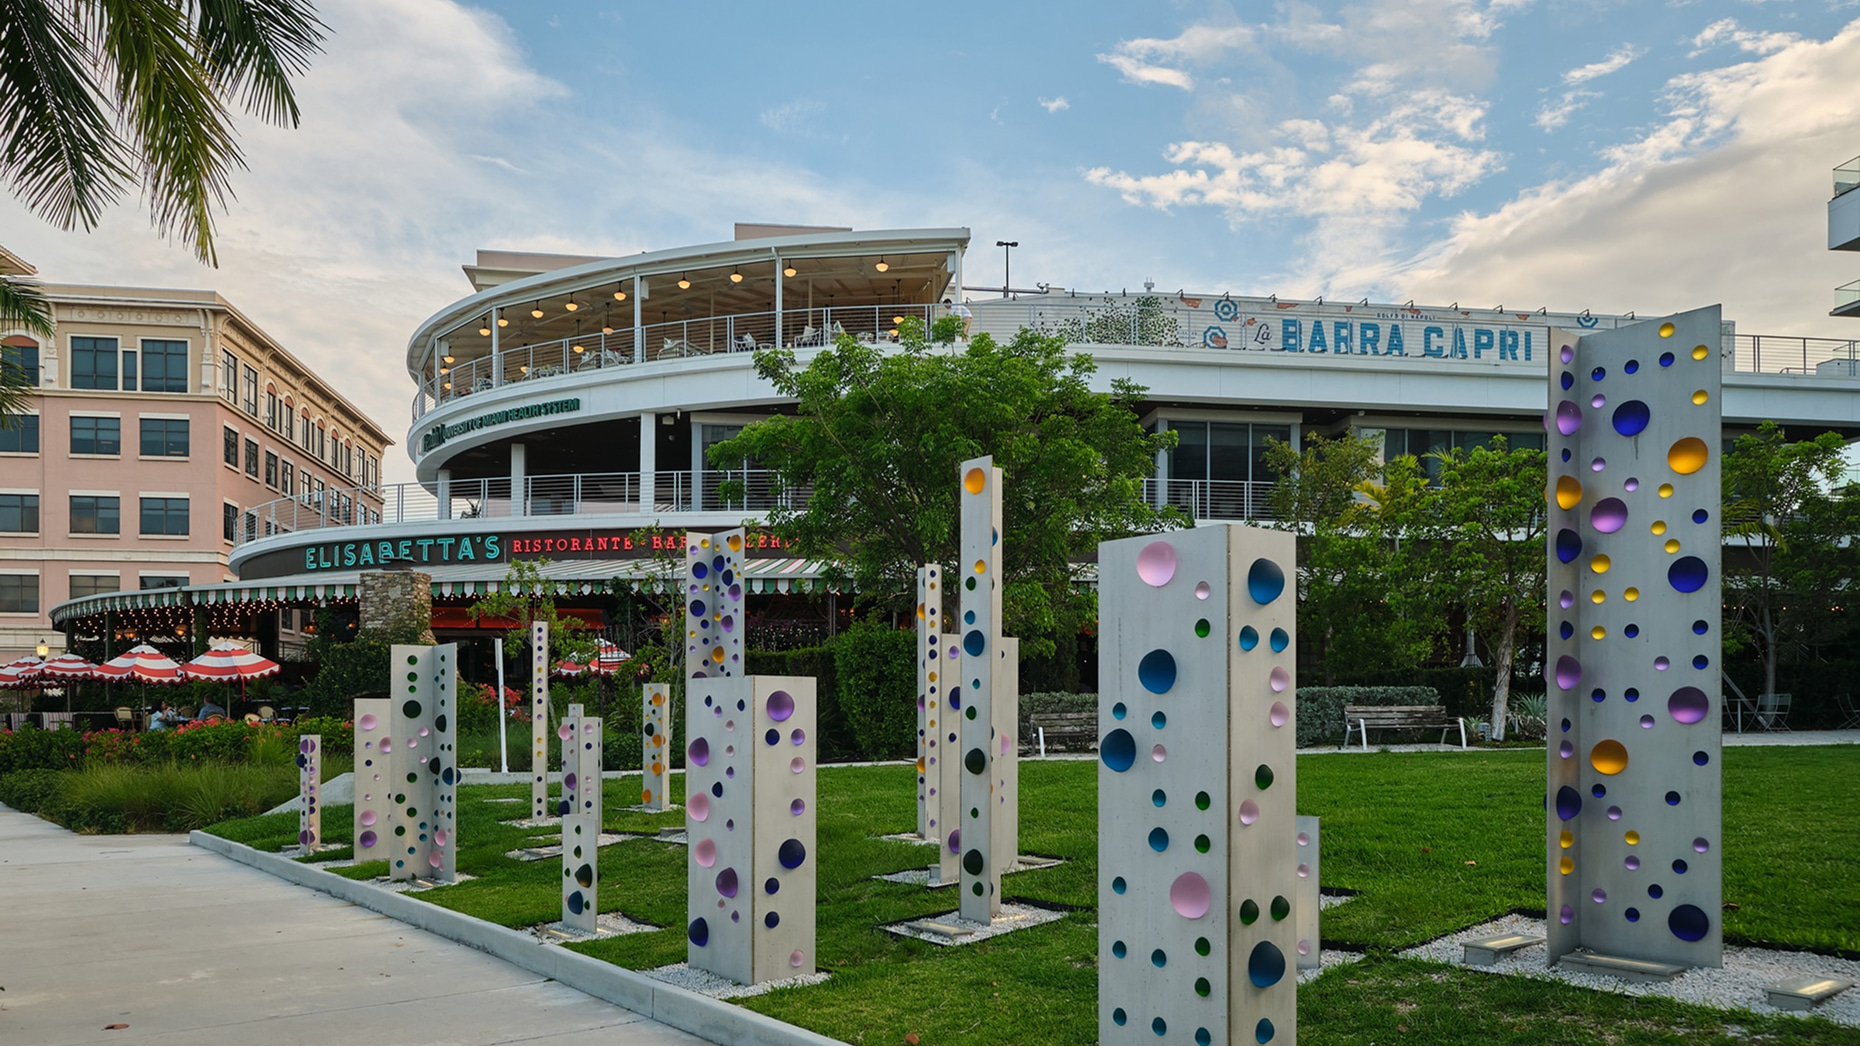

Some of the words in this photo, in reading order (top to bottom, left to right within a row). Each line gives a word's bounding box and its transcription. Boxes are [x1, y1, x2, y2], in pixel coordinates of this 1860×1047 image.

[1254, 322, 1273, 345] La
[1282, 319, 1404, 357] BARRA
[1424, 326, 1532, 361] CAPRI
[482, 410, 509, 427] MIAMI
[507, 404, 541, 421] HEALTH
[540, 398, 580, 415] SYSTEM
[305, 536, 500, 569] ELISABETTA'S
[512, 536, 633, 552] RISTORANTE
